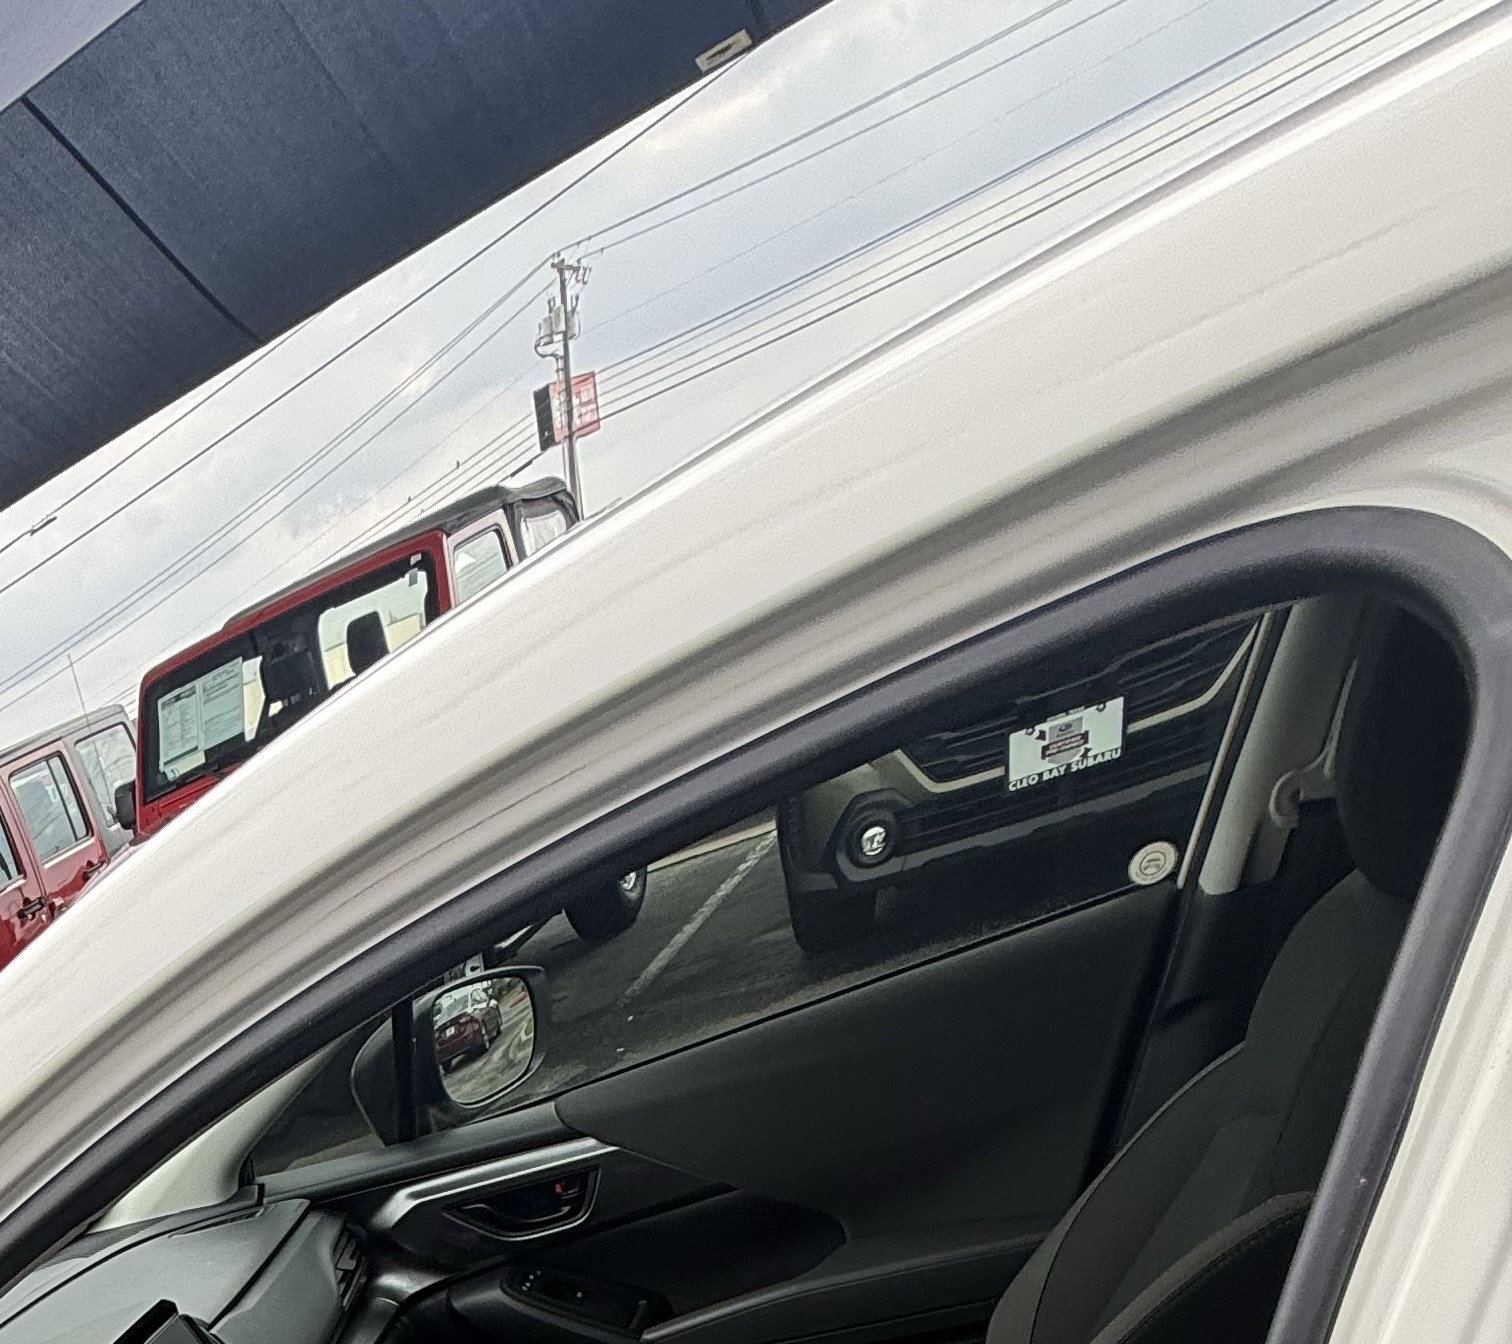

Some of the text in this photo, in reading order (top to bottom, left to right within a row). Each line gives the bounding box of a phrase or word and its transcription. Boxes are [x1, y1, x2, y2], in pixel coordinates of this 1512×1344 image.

[1008, 774, 1038, 792] CLEO
[1042, 764, 1068, 782] BAY
[1071, 748, 1122, 772] SUBARU
